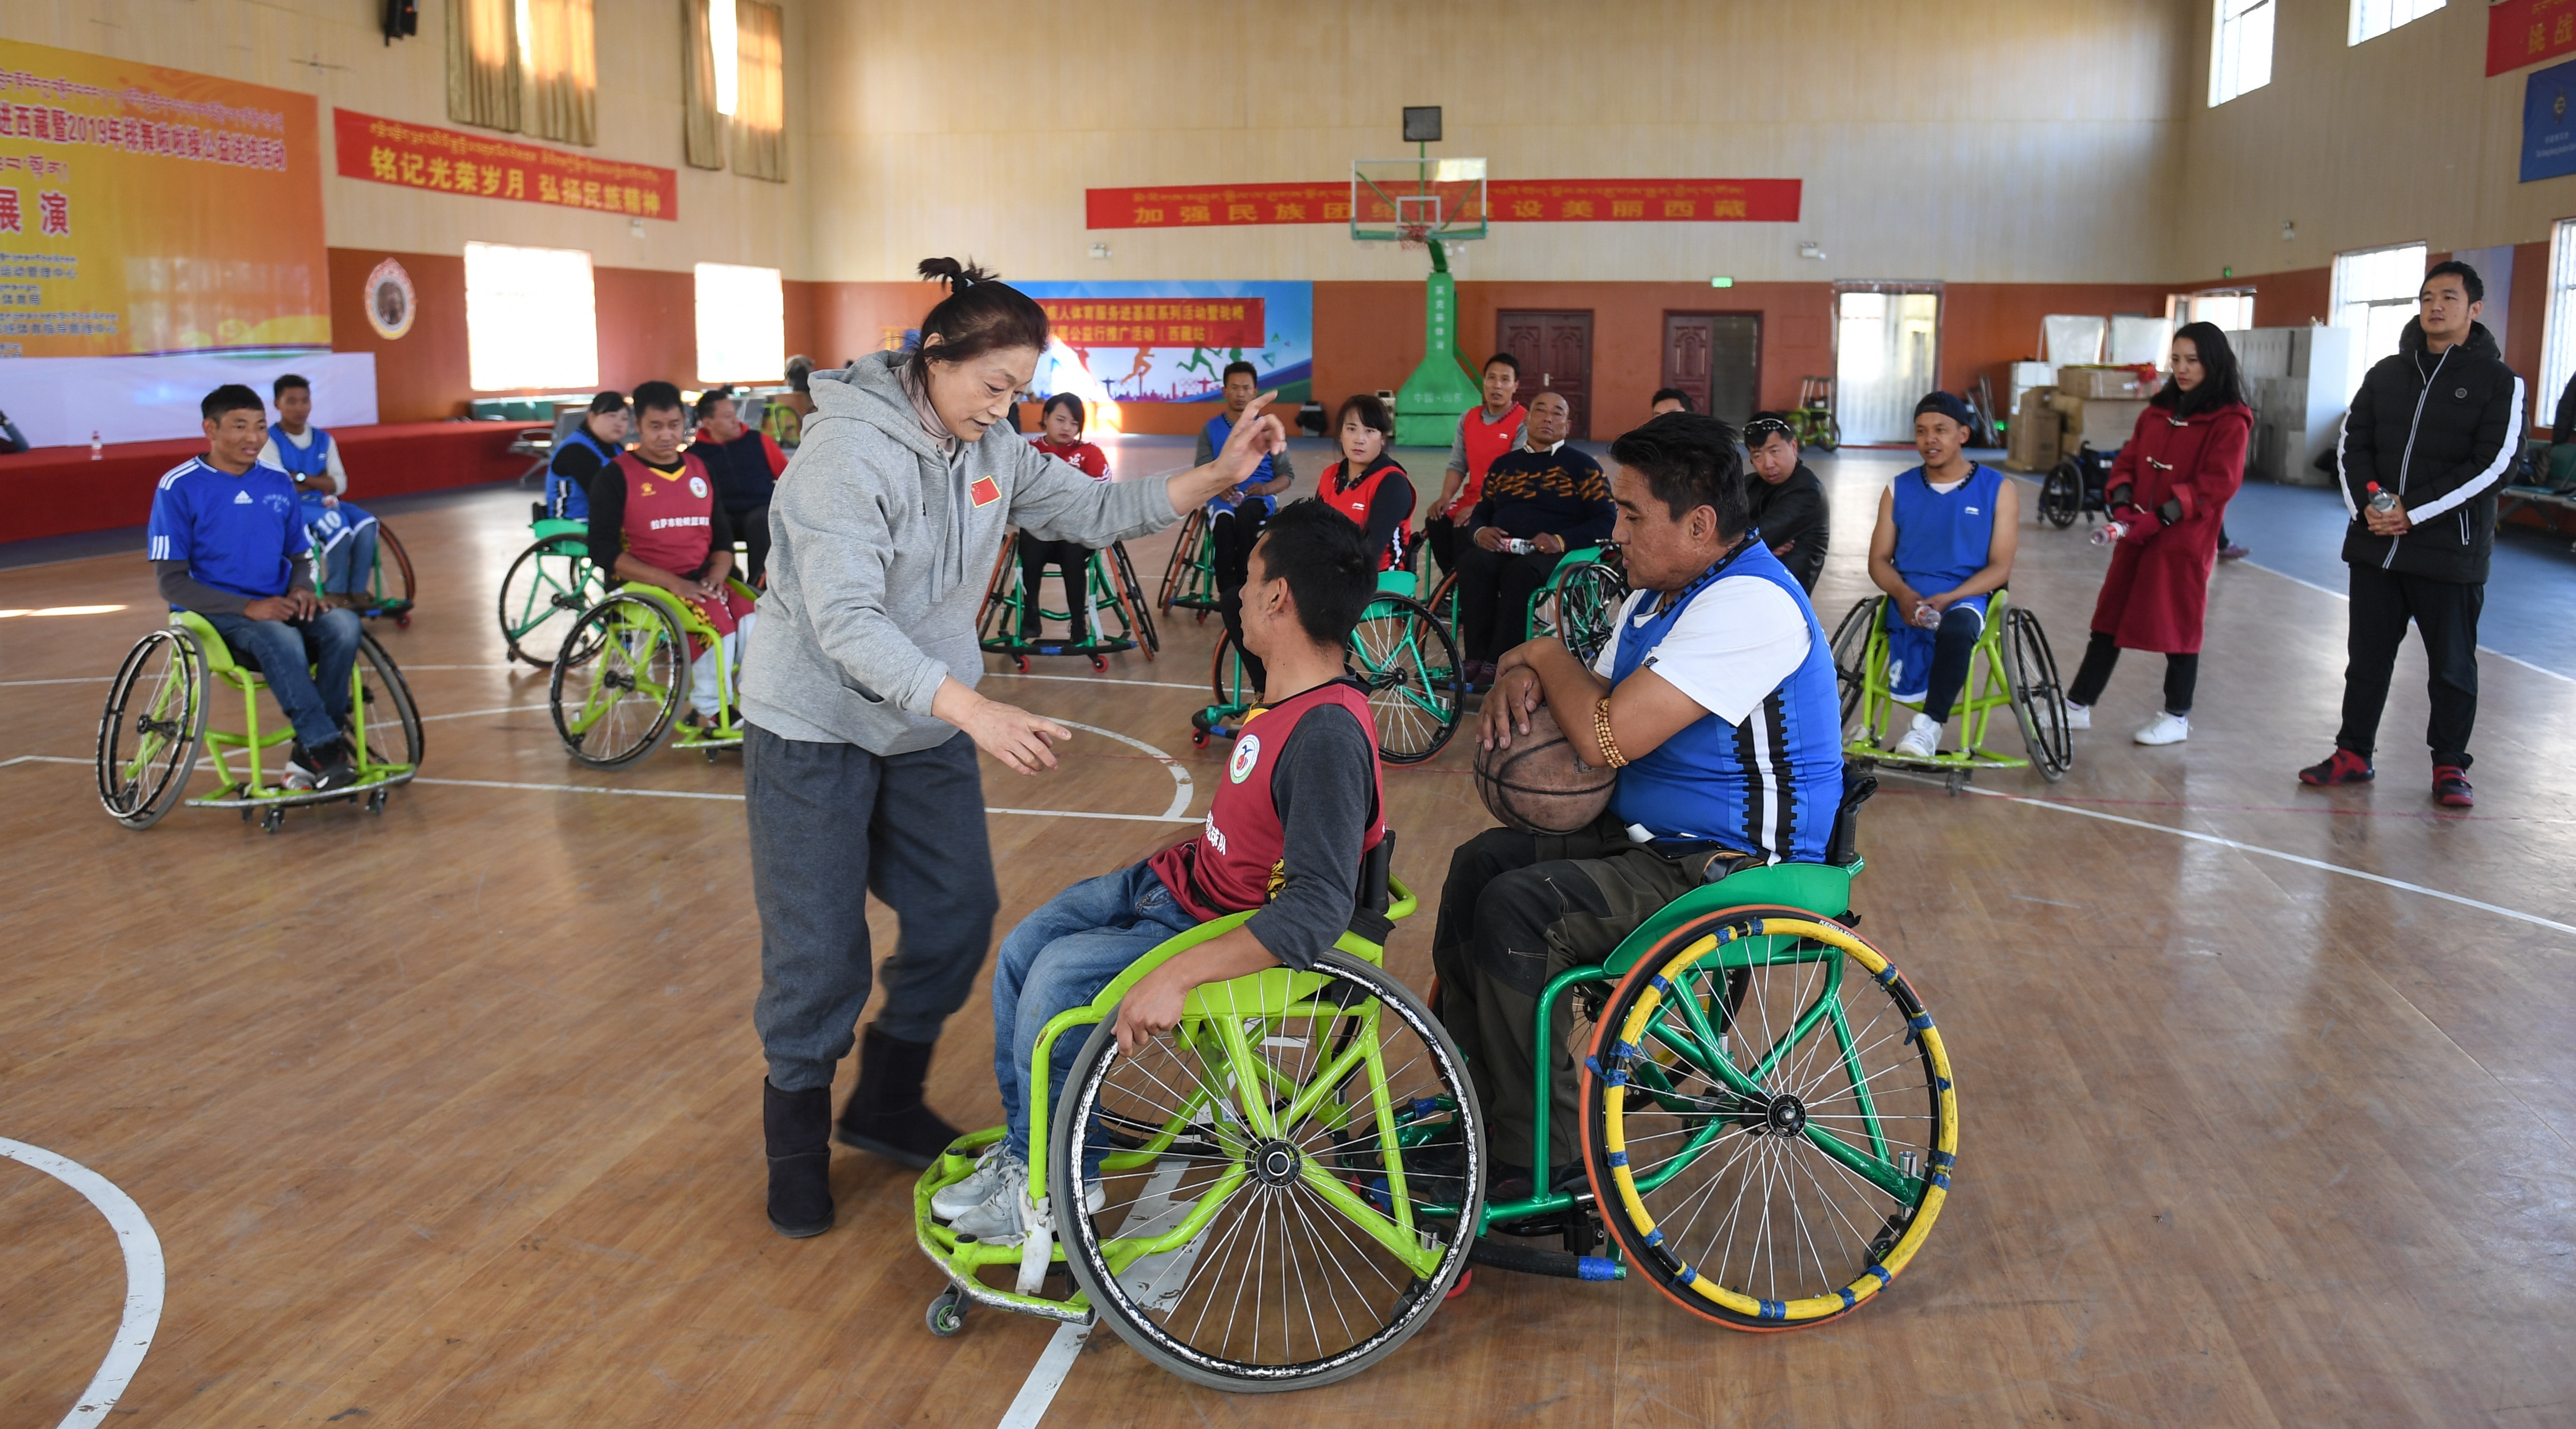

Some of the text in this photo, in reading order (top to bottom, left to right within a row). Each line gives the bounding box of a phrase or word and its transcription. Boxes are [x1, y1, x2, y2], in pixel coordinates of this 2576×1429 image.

[371, 146, 524, 199] 铭记光荣岁月
[538, 173, 660, 215] 弘扬民族精神
[317, 511, 341, 536] 10
